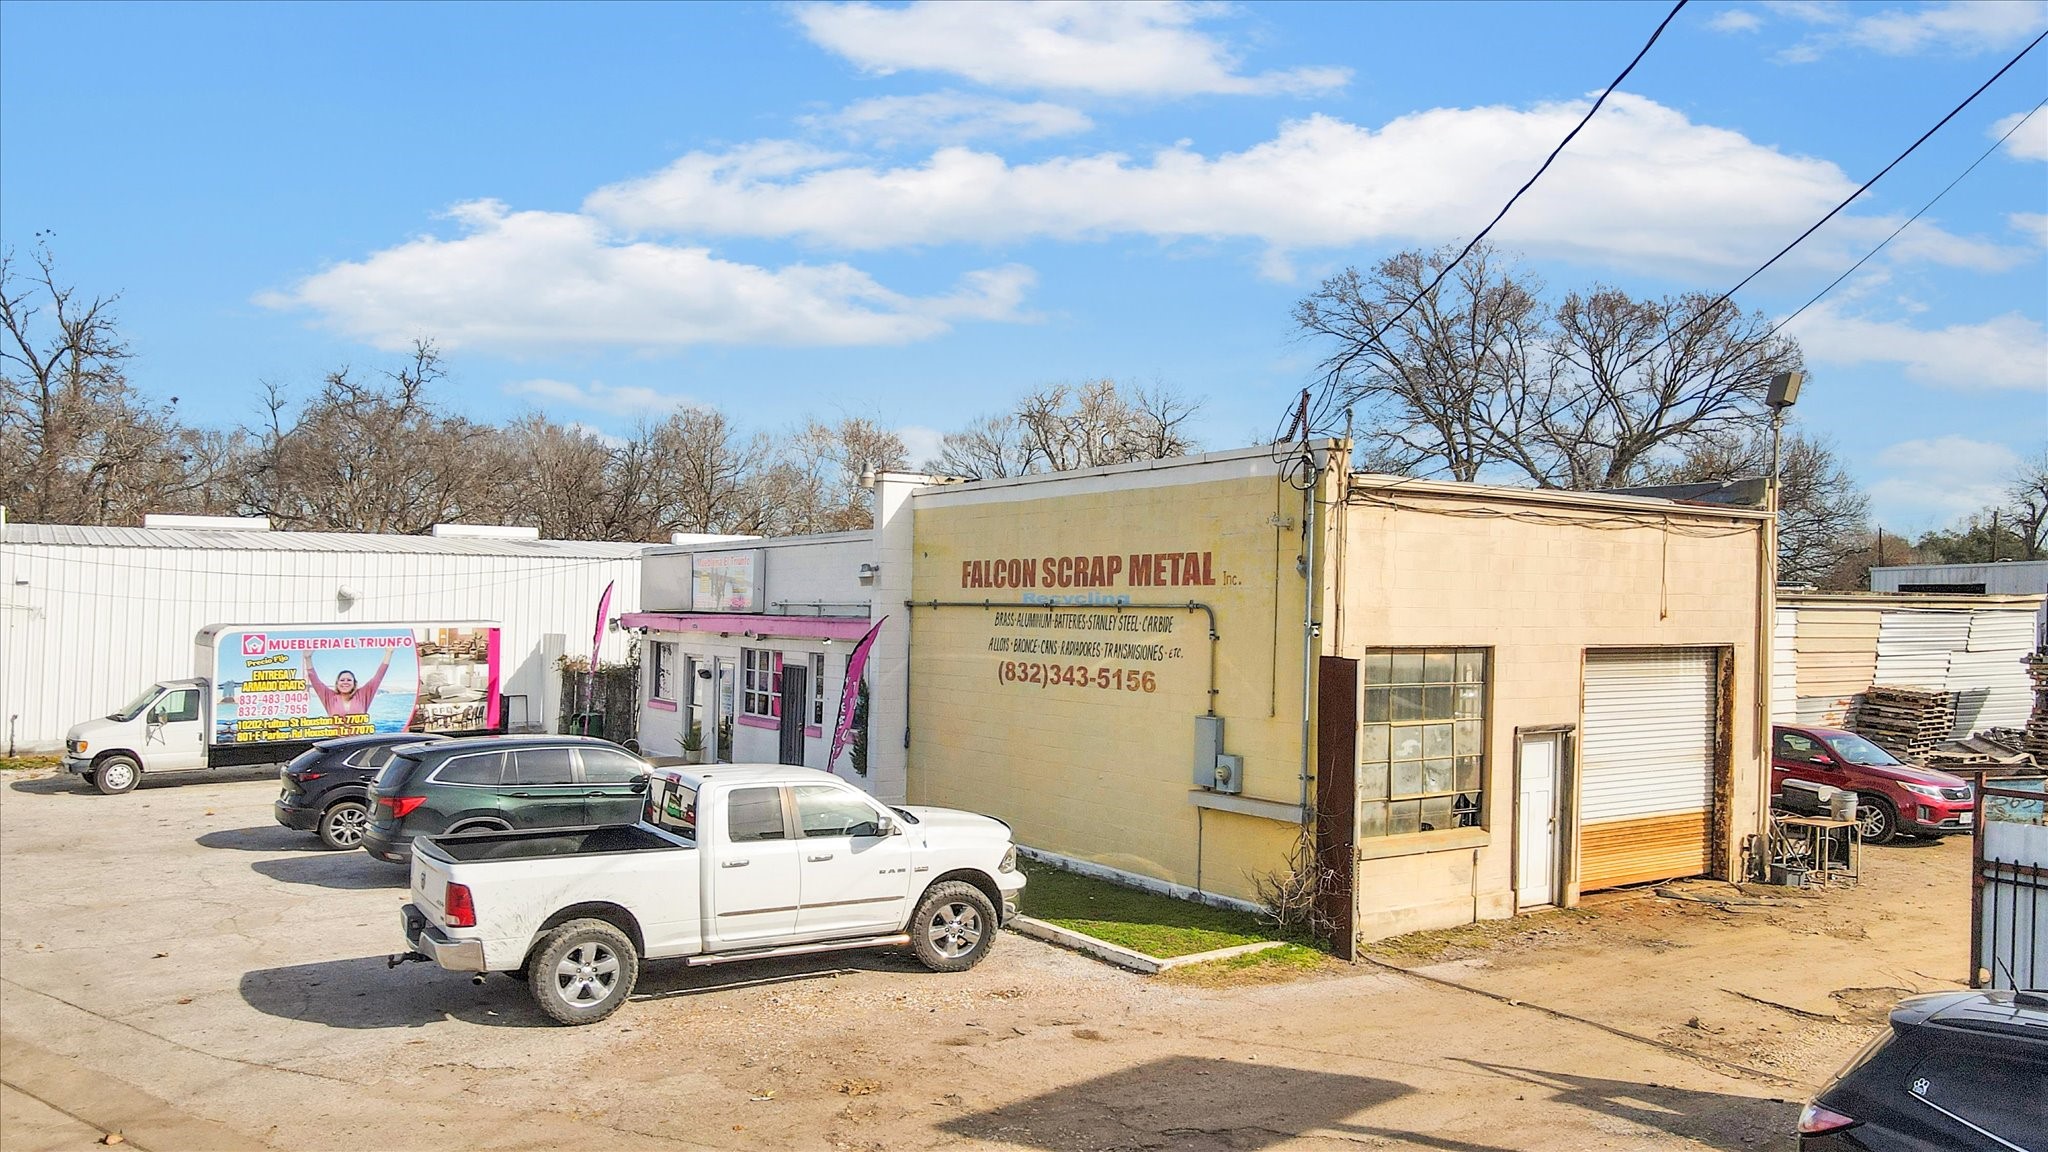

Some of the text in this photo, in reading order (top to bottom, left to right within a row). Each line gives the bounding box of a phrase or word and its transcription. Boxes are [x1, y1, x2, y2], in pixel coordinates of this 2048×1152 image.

[961, 551, 1242, 589] FALCON SCRAP METAL Inc.
[1022, 591, 1131, 605] Recycling
[269, 636, 413, 650] MUEBLERIA EL TRIUNFO
[246, 657, 273, 668] Precio
[253, 669, 297, 681] ENTREGA Y
[998, 660, 1157, 693] (832)343-5156
[242, 680, 306, 693] ARMADO GRATIS
[239, 693, 309, 706] 832-483-0404
[238, 704, 308, 717] 832-287-7956
[237, 720, 263, 731] 10202
[264, 719, 289, 729] Fulton
[301, 717, 333, 728] Houston
[346, 714, 369, 725] 77076
[304, 729, 338, 739] Houston
[350, 726, 375, 735] 77076
